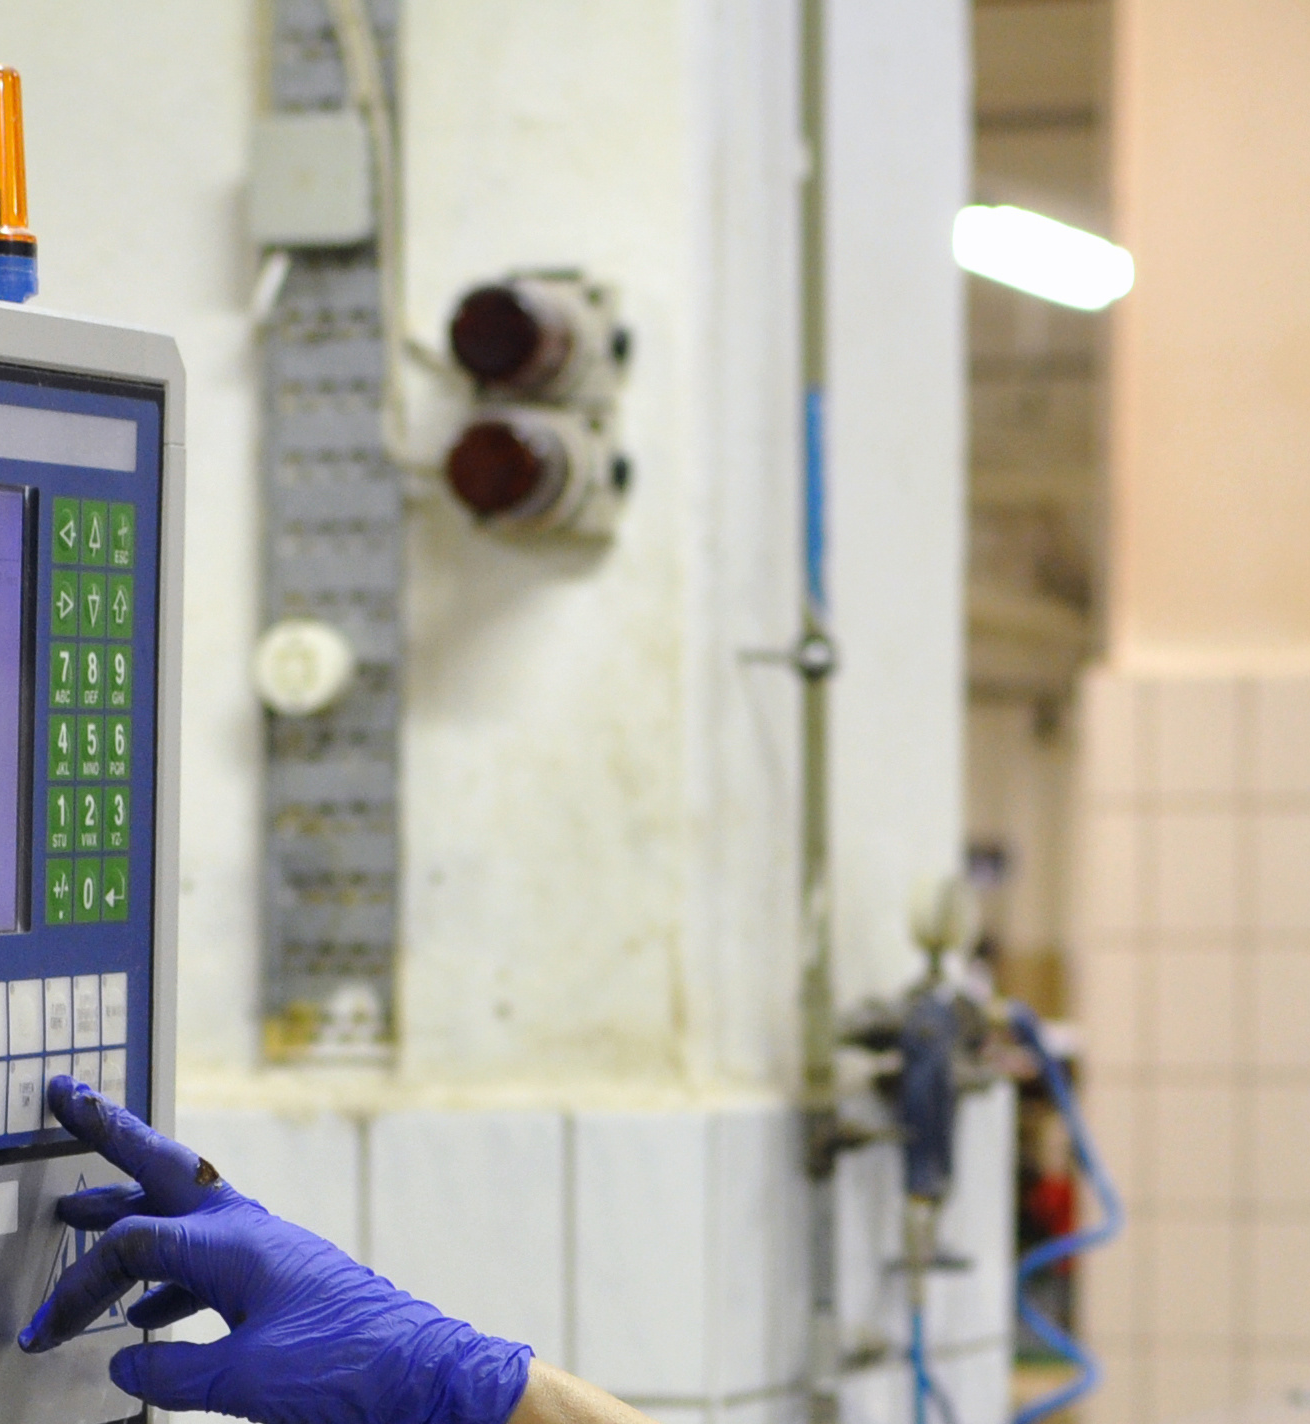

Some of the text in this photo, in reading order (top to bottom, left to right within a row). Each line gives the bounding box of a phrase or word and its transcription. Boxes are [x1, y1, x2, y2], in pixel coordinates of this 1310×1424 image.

[59, 652, 70, 683] 7
[88, 653, 98, 684] 8
[114, 654, 125, 685] 9
[54, 690, 71, 705] ABC
[84, 690, 99, 705] DEF
[58, 723, 68, 754] 4
[87, 724, 97, 755] 5
[115, 724, 125, 755] 6
[55, 762, 71, 776] JKL
[57, 795, 66, 827] 1
[85, 795, 96, 826] 2
[114, 795, 125, 826] 3
[52, 834, 68, 849] STU
[83, 878, 94, 910] 0
